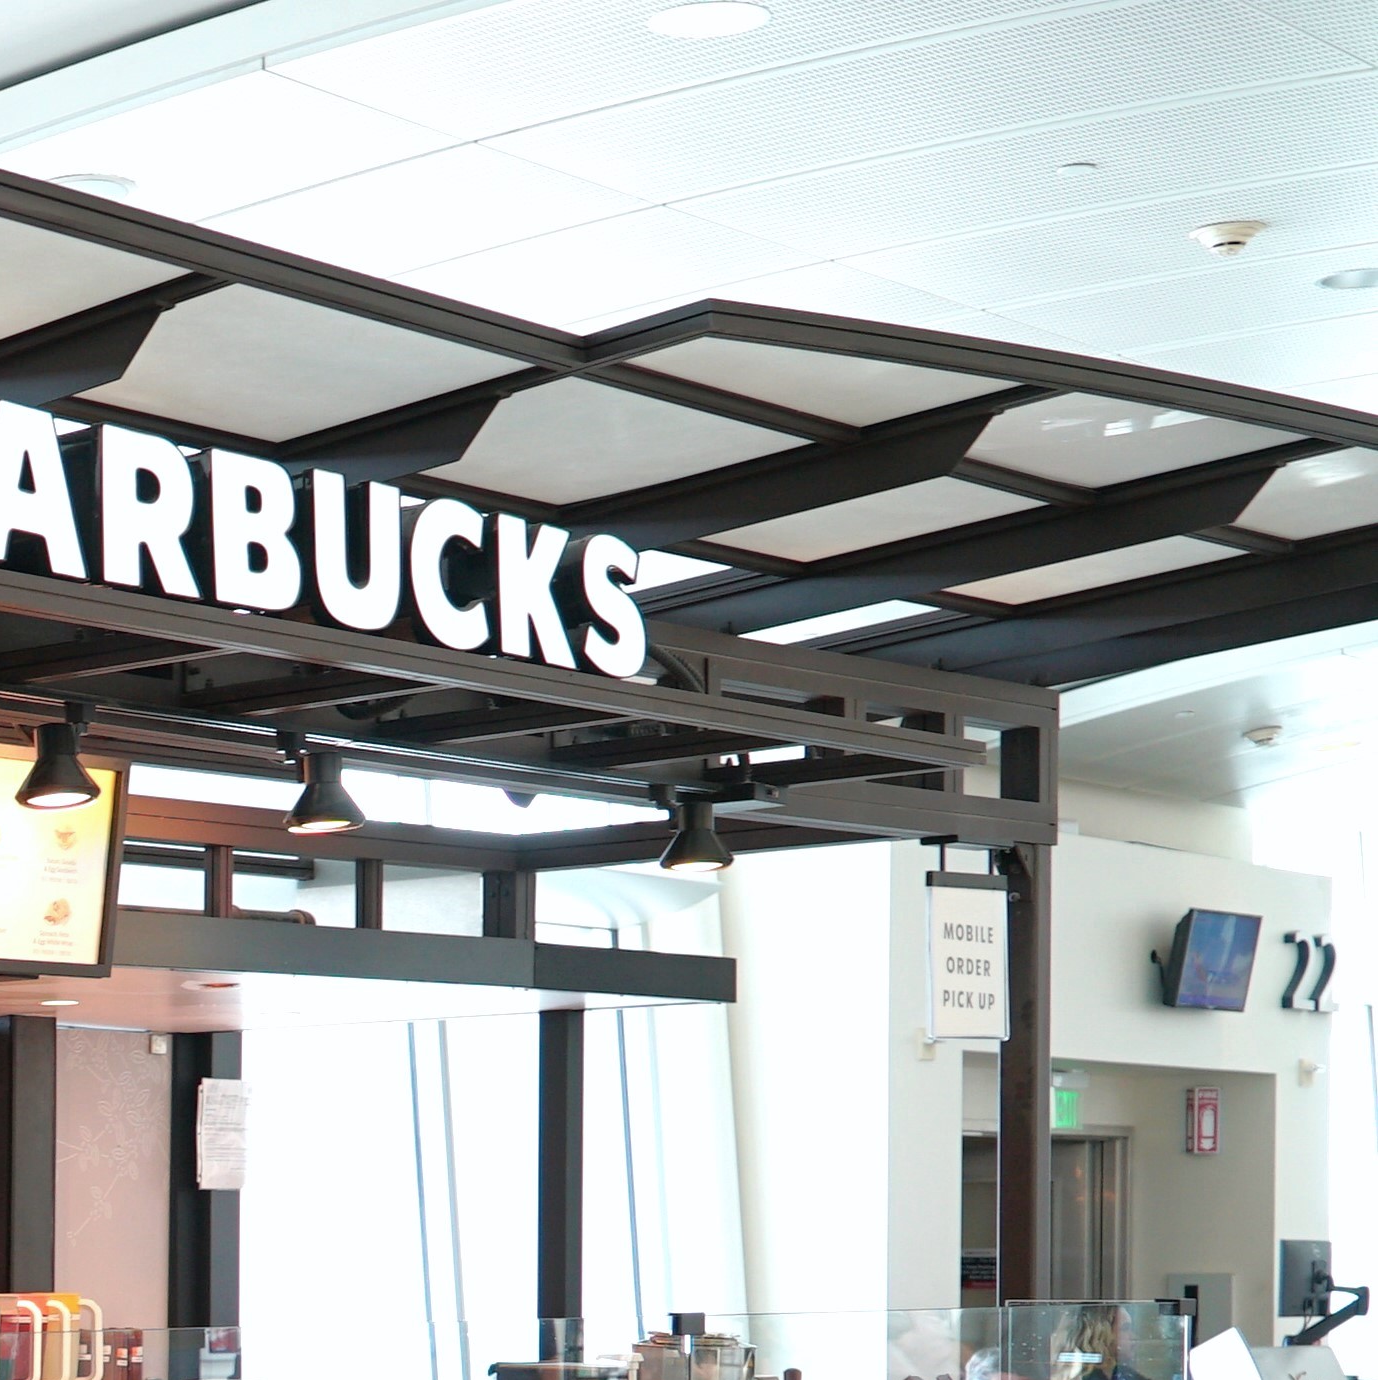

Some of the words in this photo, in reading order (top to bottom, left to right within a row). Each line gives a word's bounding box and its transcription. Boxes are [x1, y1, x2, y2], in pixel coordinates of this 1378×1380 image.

[943, 922, 994, 944] MOBILE
[946, 956, 991, 977] ORDER
[1281, 930, 1339, 1013] 22
[943, 989, 974, 1009] PICK
[978, 992, 995, 1010] UP
